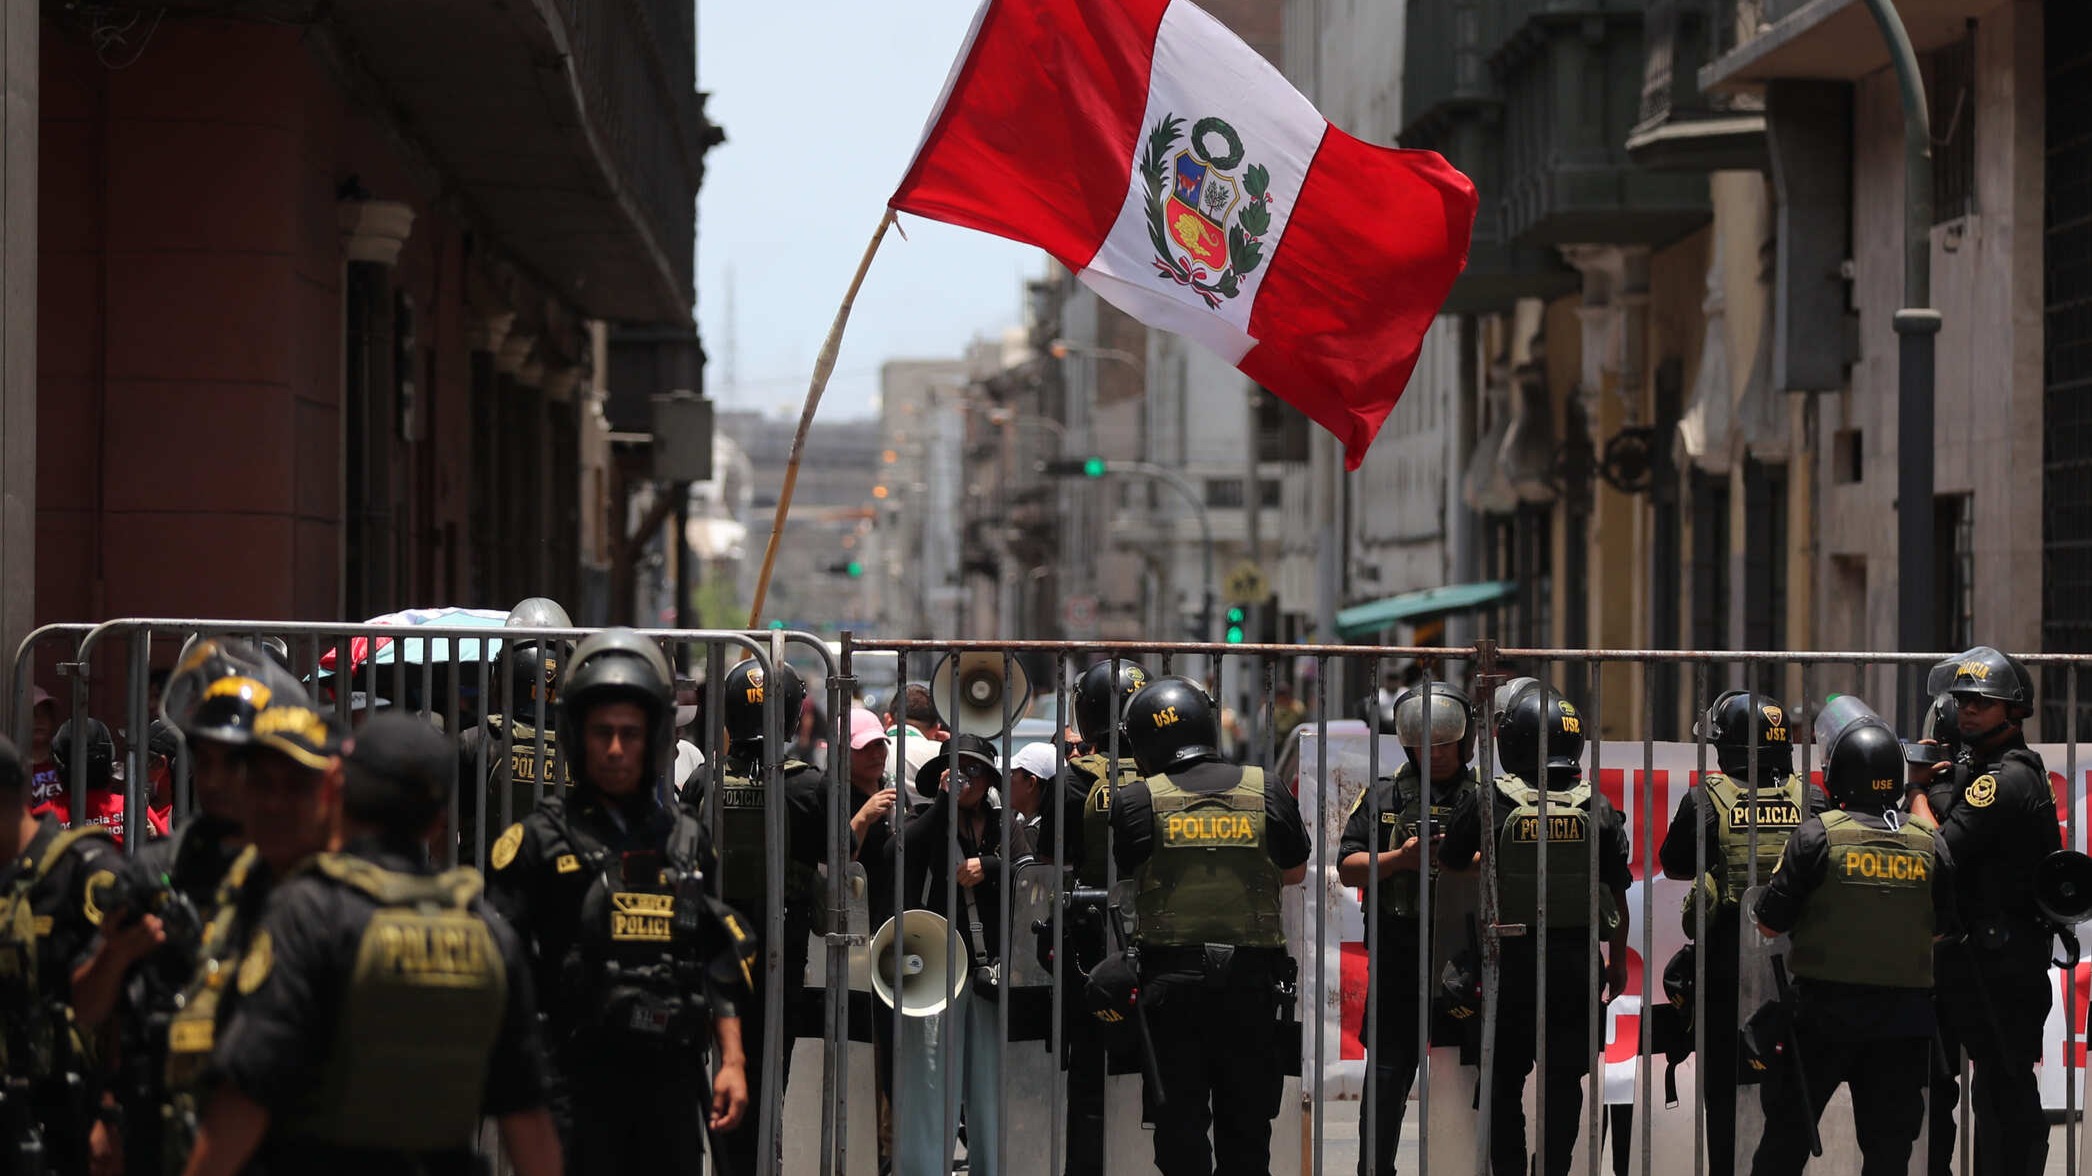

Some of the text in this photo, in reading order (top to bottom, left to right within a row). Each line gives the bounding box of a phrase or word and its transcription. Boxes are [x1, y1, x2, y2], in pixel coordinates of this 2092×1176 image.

[746, 688, 764, 703] US
[1152, 706, 1180, 728] USE
[1562, 717, 1580, 733] USE
[1872, 779, 1894, 790] USE
[1168, 816, 1254, 840] POLICIA
[1521, 818, 1580, 840] POICIA
[1846, 852, 1927, 881] POLICIA
[615, 914, 670, 935] POLICI
